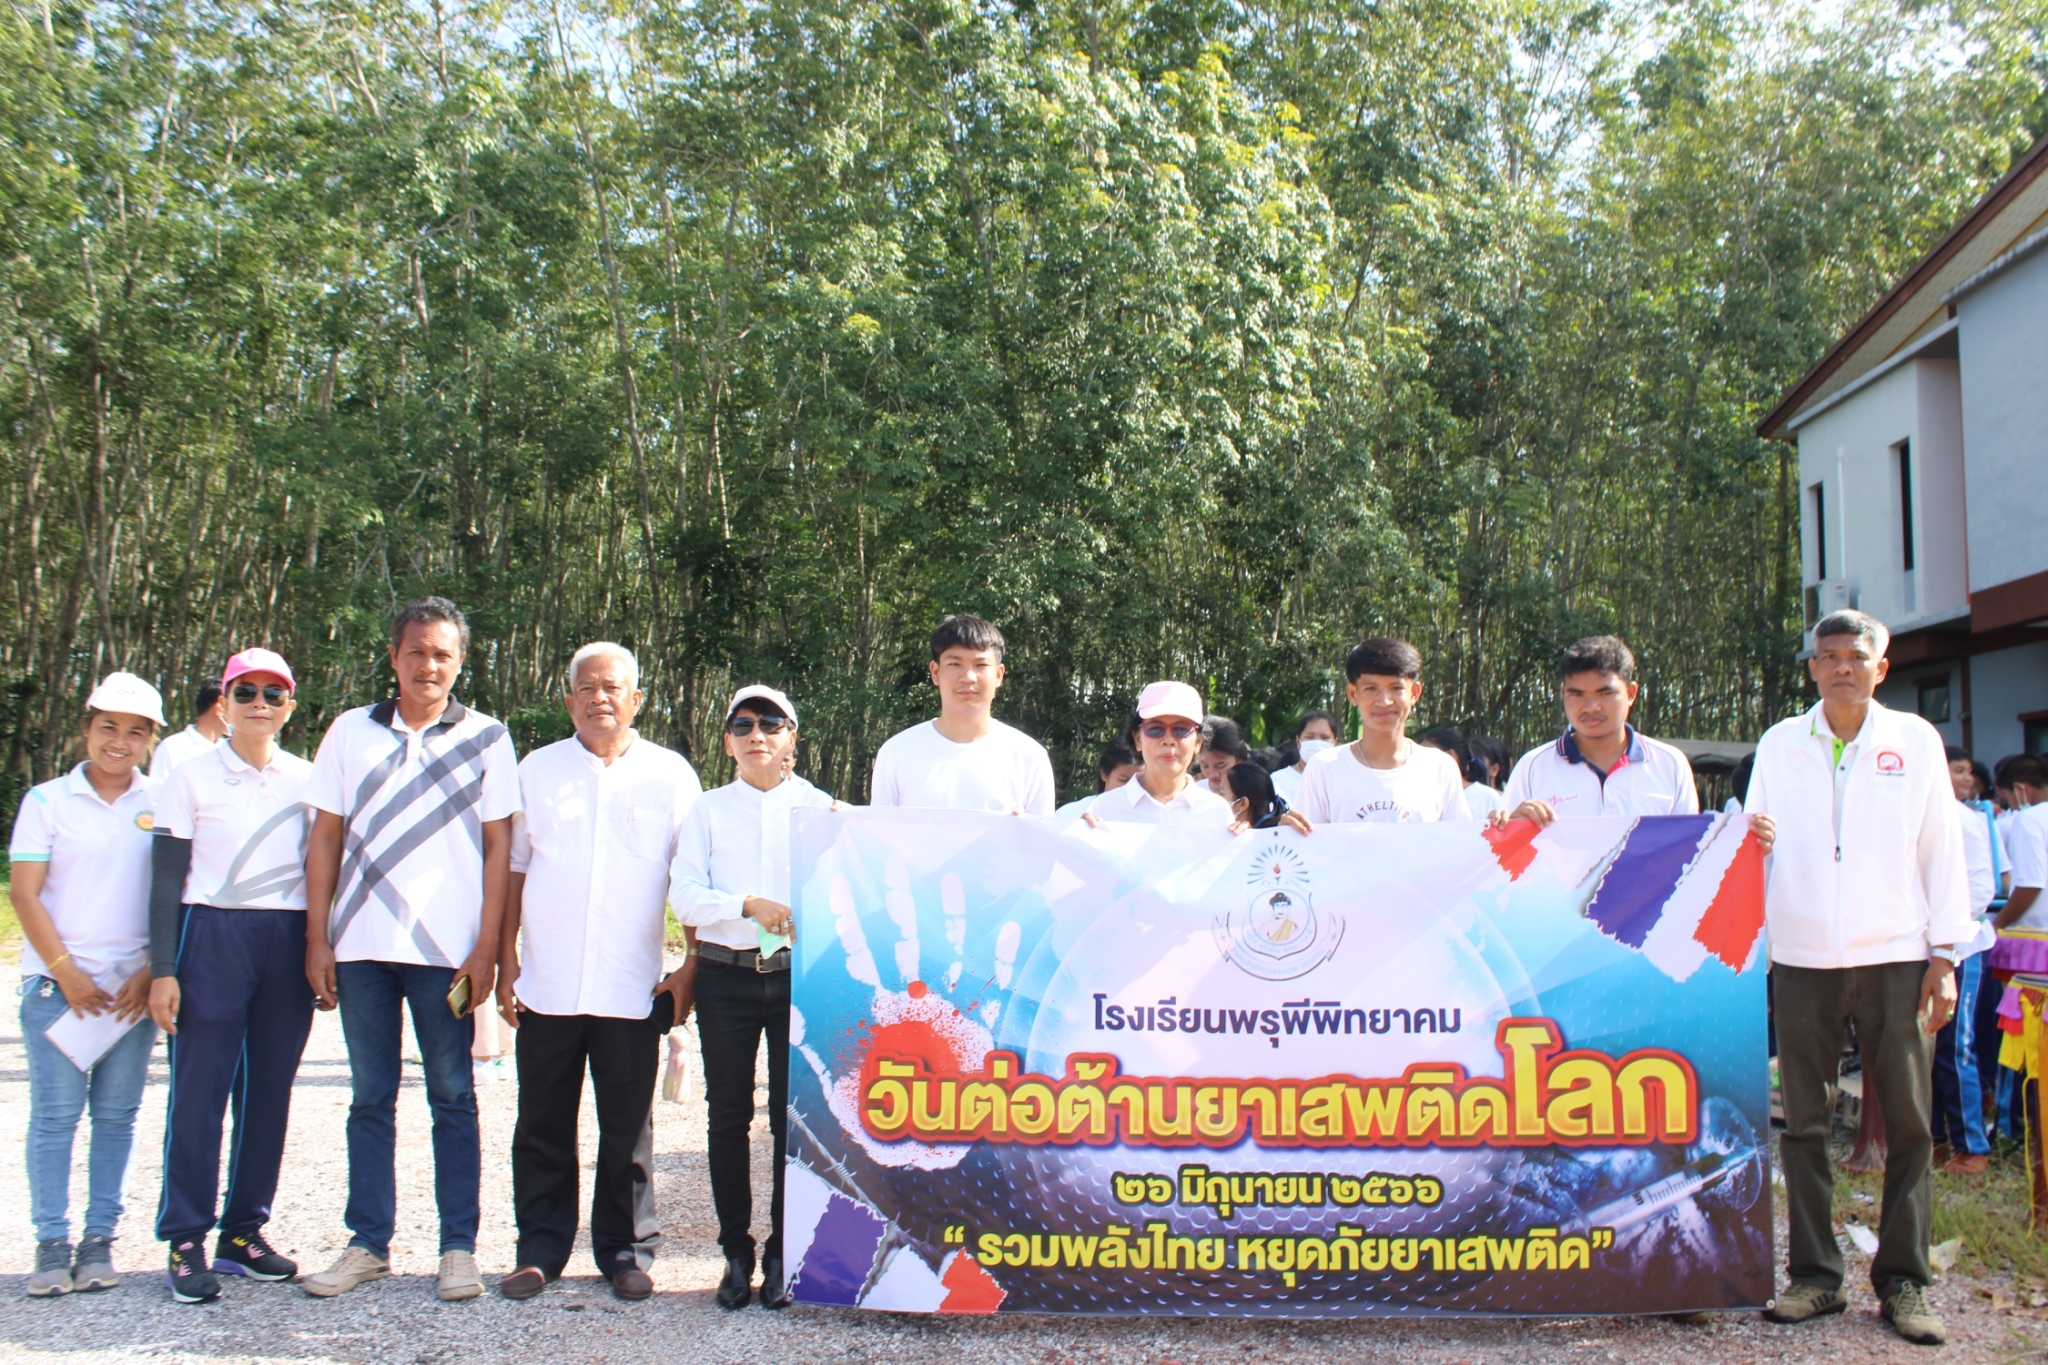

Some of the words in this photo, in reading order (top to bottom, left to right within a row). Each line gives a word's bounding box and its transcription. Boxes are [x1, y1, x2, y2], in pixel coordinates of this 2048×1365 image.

[1092, 993, 1461, 1048] โรงเรียนพรุพีพิทยาคม
[866, 1025, 1690, 1137] วันต่อต้านยาเสพติดโลก
[1114, 1174, 1172, 1204] ๒๖
[1181, 1168, 1323, 1218] มิถุนายน
[1330, 1174, 1441, 1205] ๒๕๖๖
[976, 1223, 1225, 1271] รวมพลังไทย
